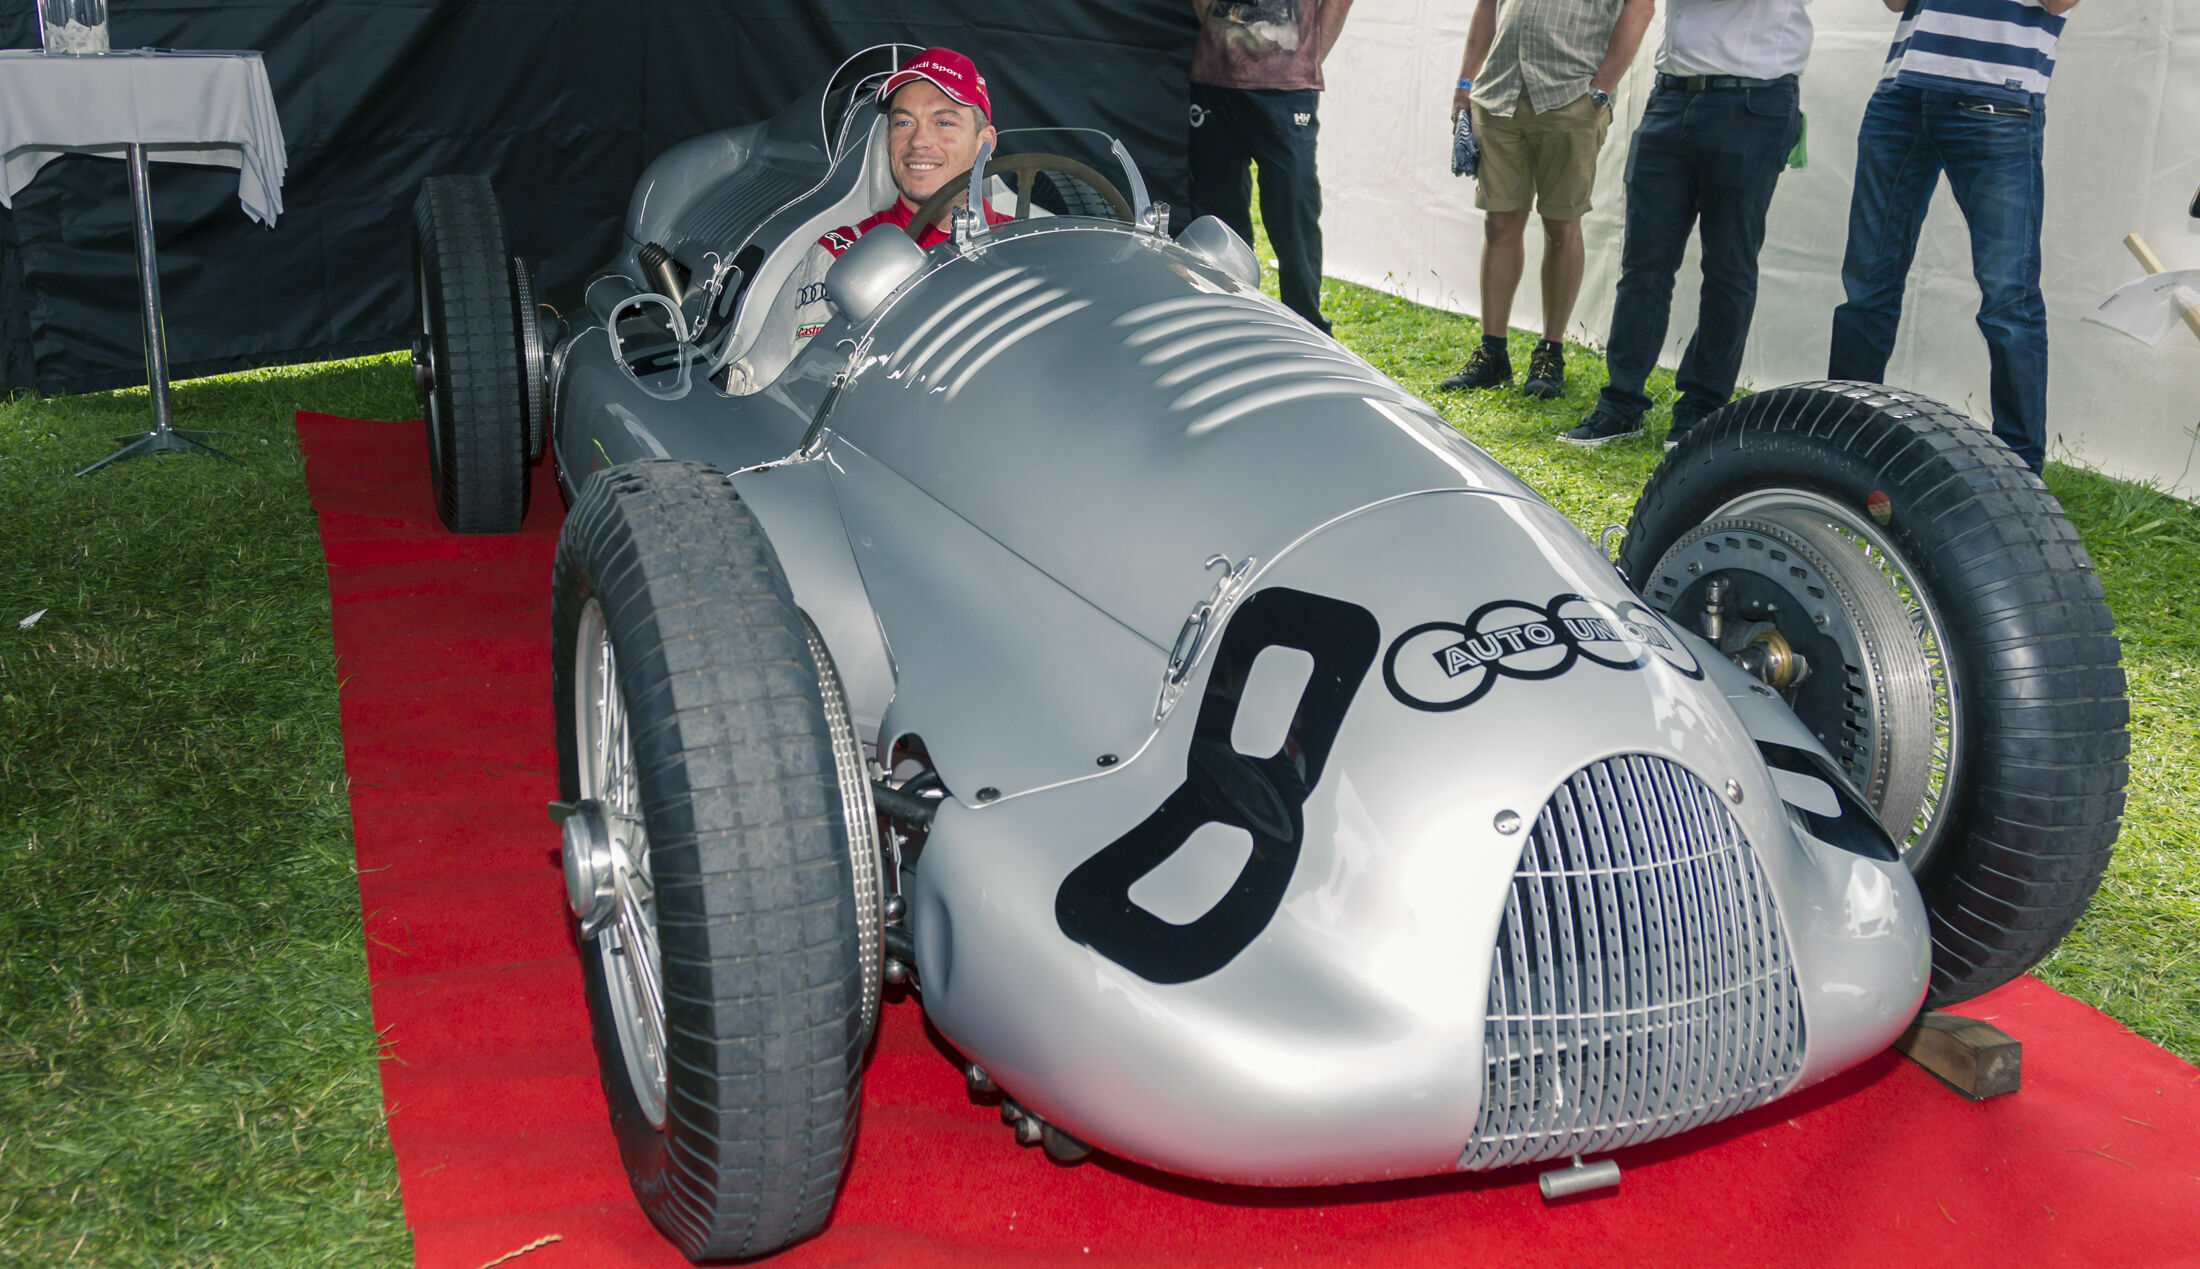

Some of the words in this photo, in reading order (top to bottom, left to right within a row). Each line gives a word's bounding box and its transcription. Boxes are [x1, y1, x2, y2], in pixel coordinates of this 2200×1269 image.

[909, 61, 930, 70] udi
[931, 62, 964, 80] Sport
[796, 324, 823, 338] Castr
[1444, 622, 1556, 677] AUTO
[1562, 618, 1672, 651] UNON
[1055, 586, 1381, 985] 8
